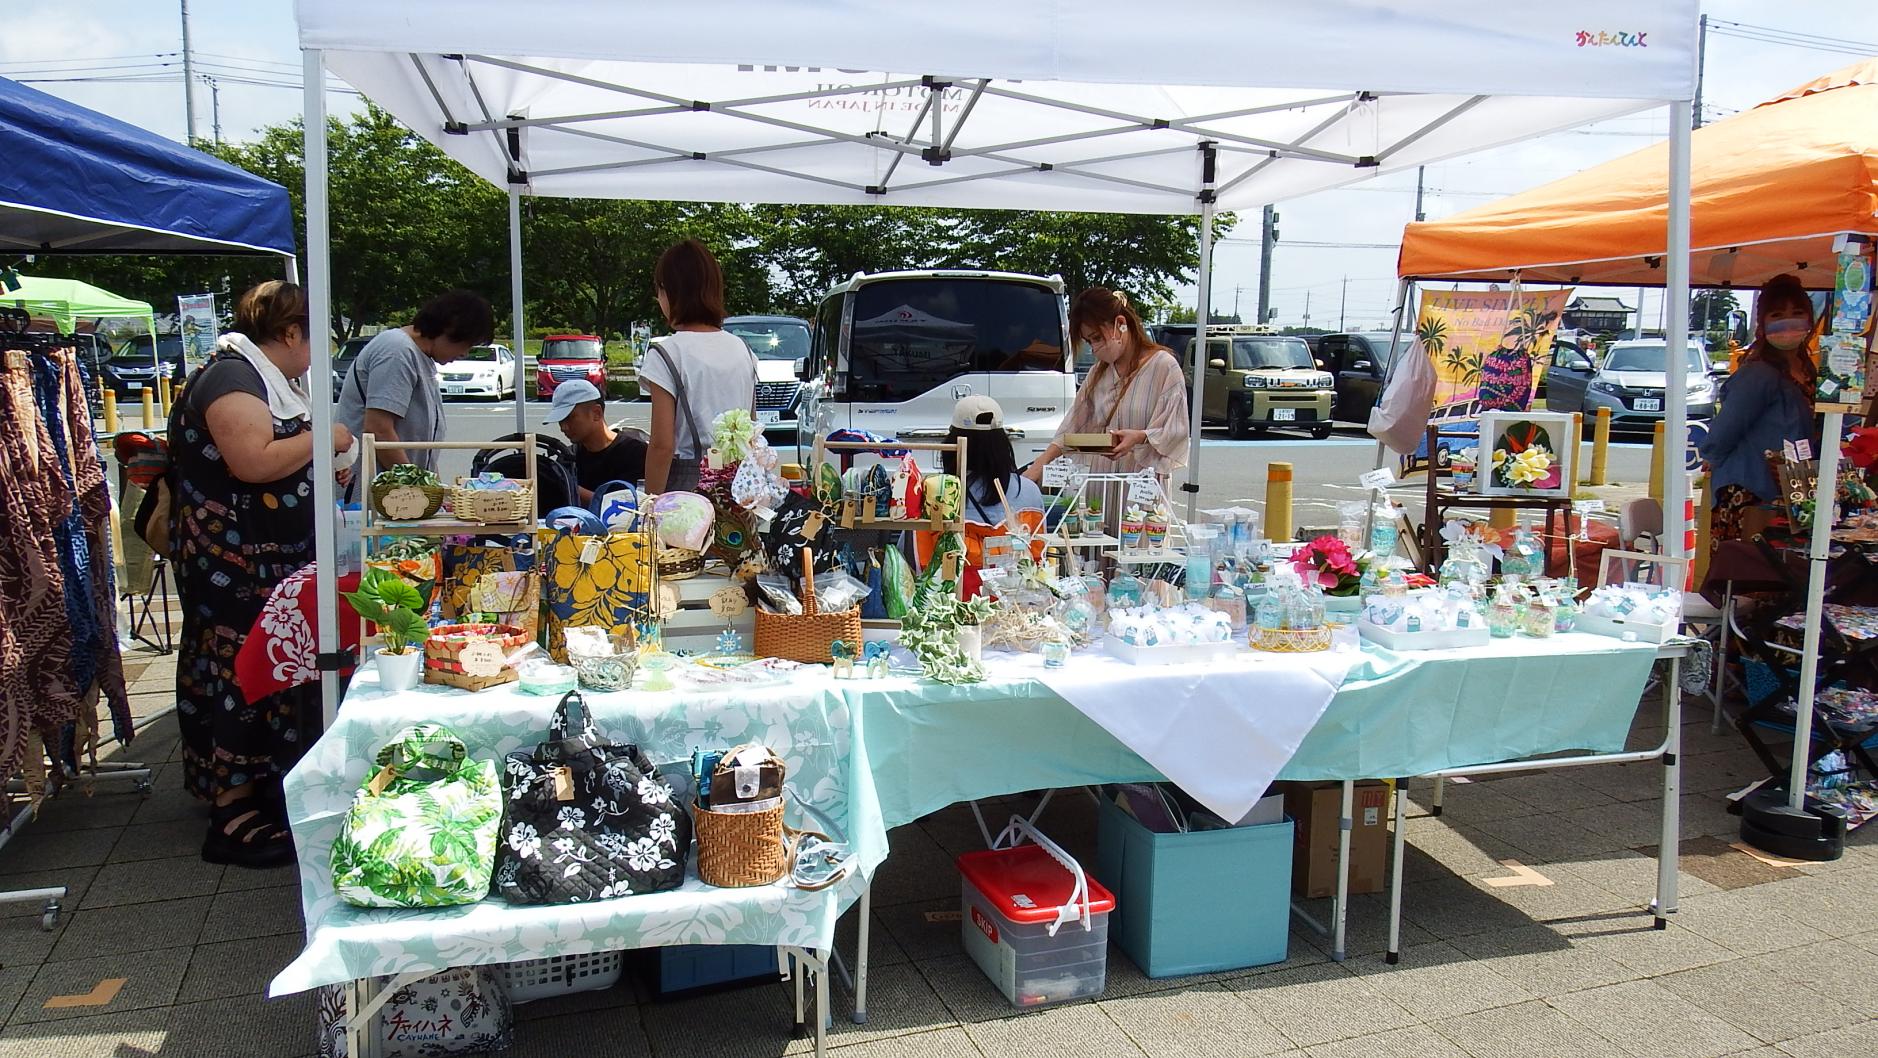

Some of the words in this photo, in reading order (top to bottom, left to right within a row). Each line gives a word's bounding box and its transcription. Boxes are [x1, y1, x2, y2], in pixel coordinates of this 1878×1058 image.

[1575, 30, 1648, 47] かんたんてんと
[1432, 297, 1475, 313] LIVE
[976, 913, 993, 937] SKIP
[388, 1009, 453, 1040] チャイハネ
